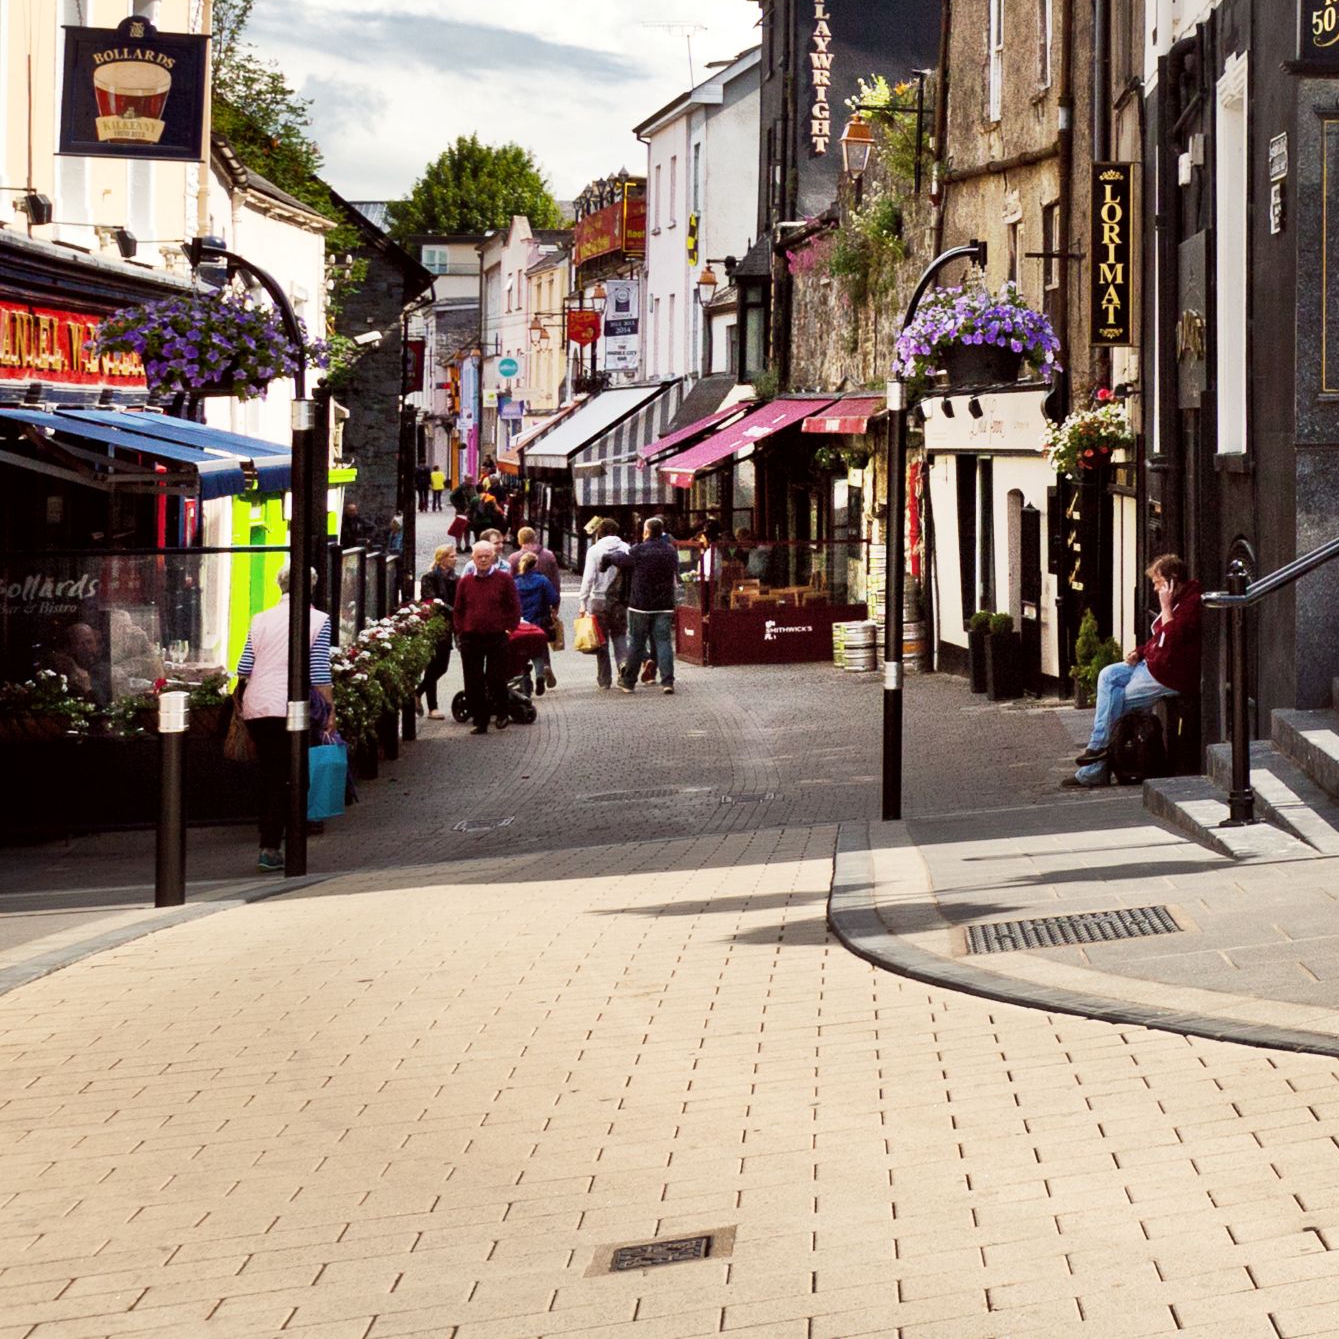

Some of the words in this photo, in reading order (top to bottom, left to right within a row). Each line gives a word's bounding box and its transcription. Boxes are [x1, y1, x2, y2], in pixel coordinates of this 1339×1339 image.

[92, 48, 176, 70] BOLLARDS
[1098, 184, 1125, 325] LORIMAT
[40, 602, 78, 614] Bistro
[766, 626, 813, 634] SMITHWICK'S
